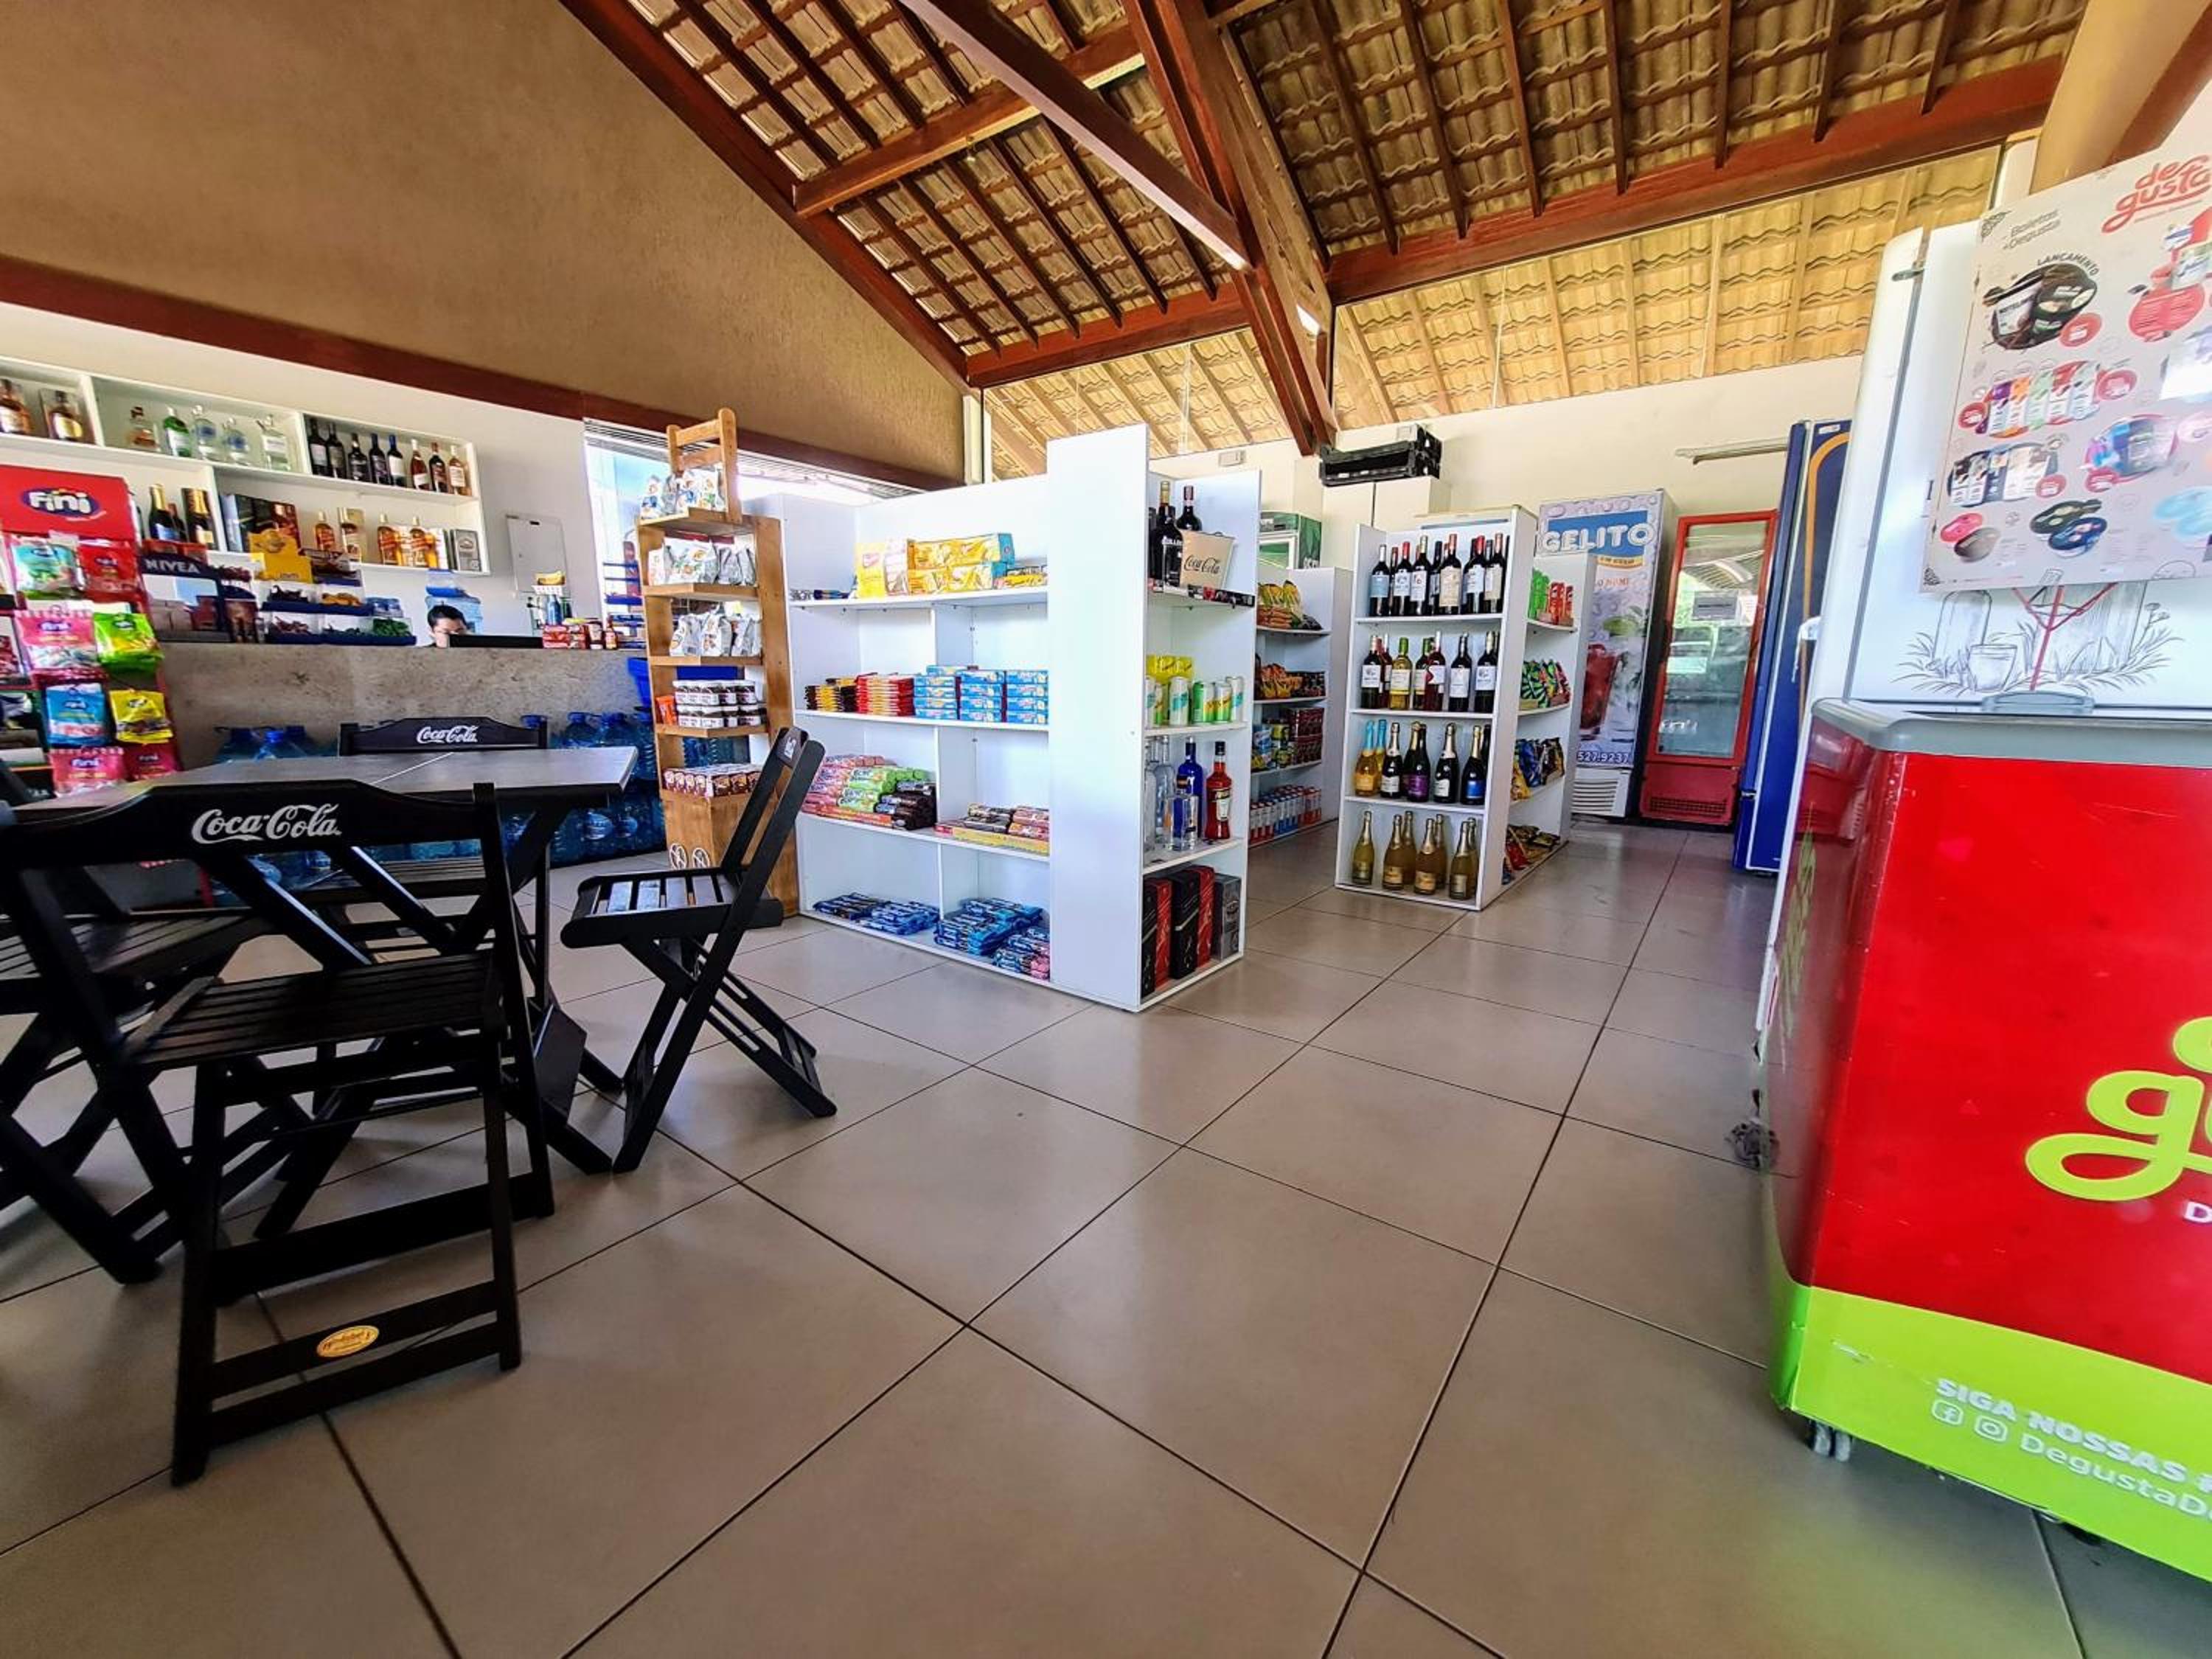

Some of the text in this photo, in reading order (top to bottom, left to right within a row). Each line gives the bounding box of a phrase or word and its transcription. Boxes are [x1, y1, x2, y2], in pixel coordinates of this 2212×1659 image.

[1542, 523, 1655, 553] GELITO
[145, 558, 201, 574] NIVEA
[191, 803, 342, 844] Coca-Cola
[1935, 1378, 2188, 1483] SIGA NOSSAS
[2020, 1433, 2212, 1521] DegustaD
